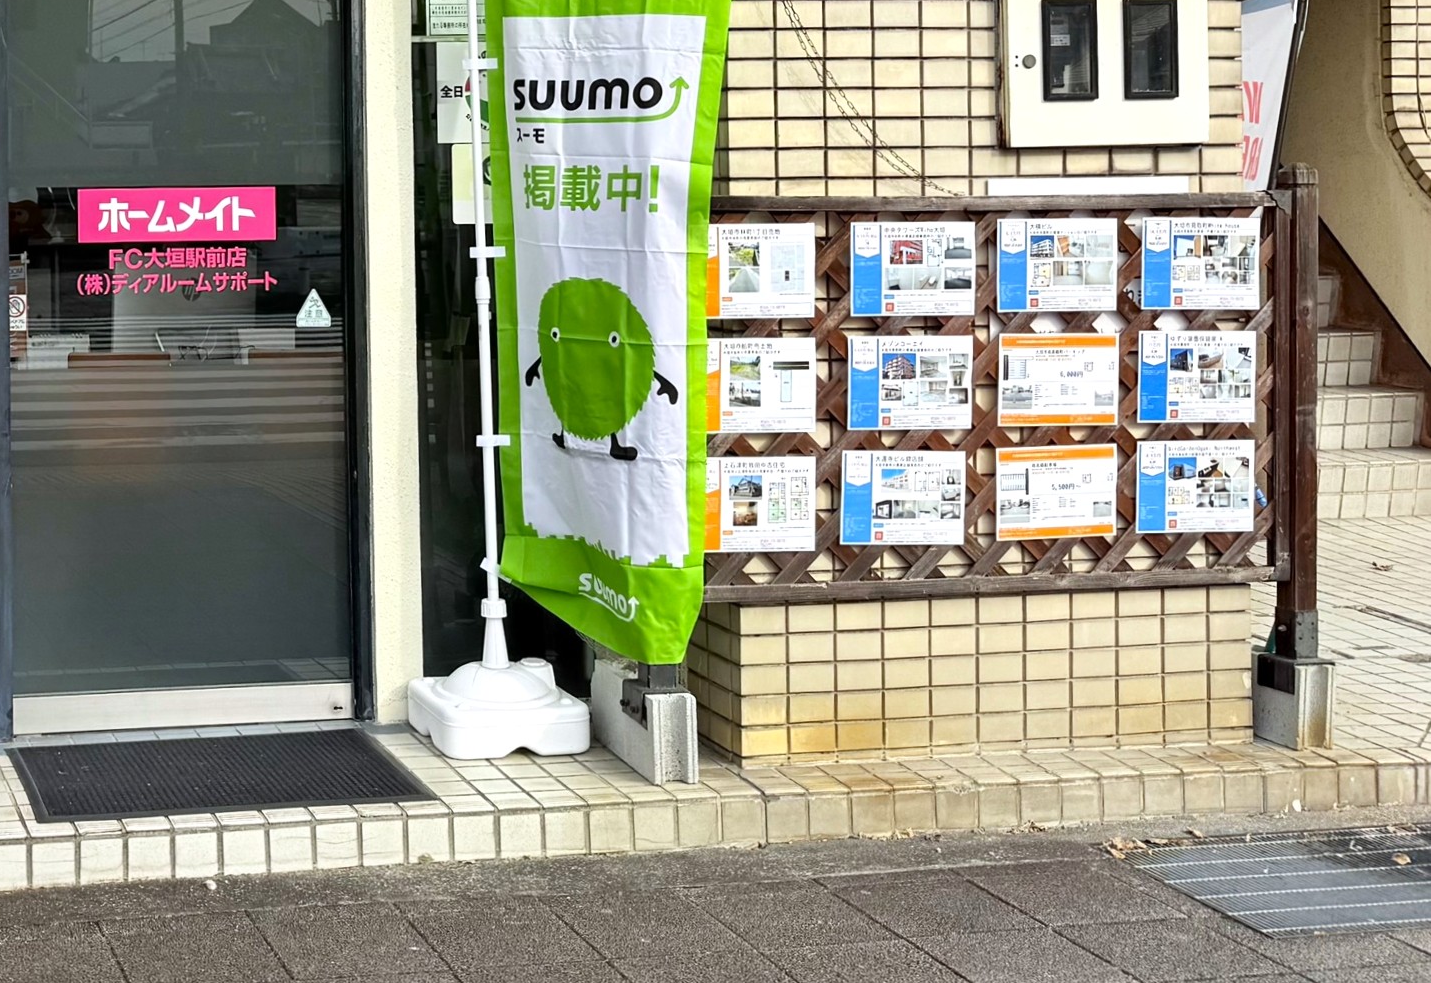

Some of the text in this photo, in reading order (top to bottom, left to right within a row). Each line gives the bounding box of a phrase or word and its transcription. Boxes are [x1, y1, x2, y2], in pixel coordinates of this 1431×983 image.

[523, 164, 661, 213] 掲載中!
[98, 196, 256, 233] ホームメイト
[109, 246, 247, 270] FC大垣駅前店
